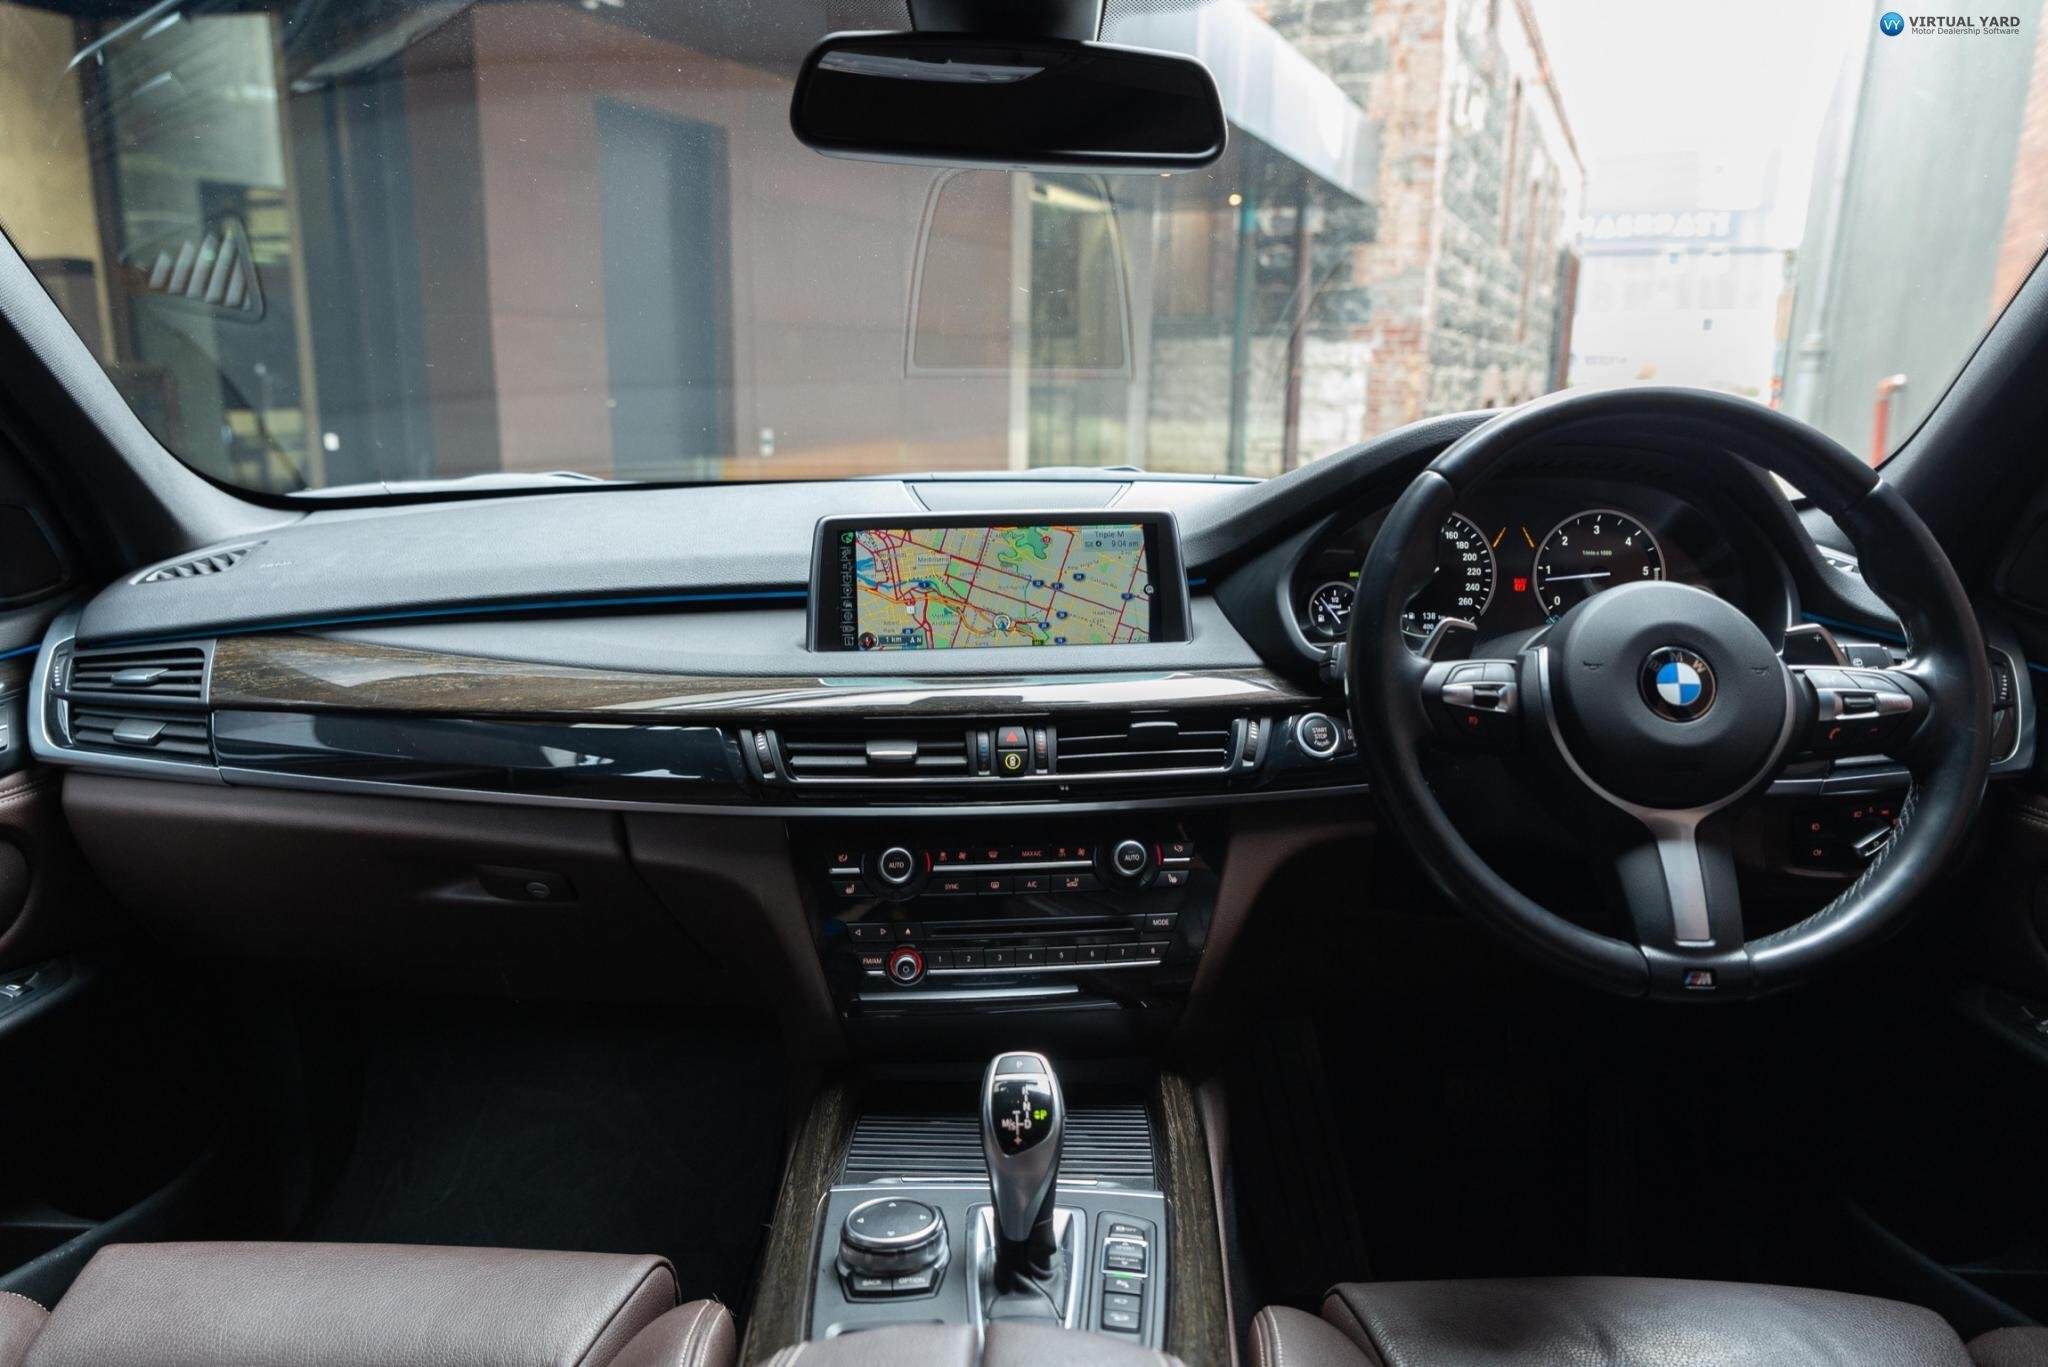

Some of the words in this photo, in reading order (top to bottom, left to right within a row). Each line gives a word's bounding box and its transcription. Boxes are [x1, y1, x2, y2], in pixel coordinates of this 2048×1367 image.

[1593, 525, 1600, 535] 3
[1095, 531, 1115, 539] Triple
[1445, 531, 1459, 540] 160
[1456, 541, 1470, 550] 180
[1562, 536, 1569, 546] 2
[1625, 537, 1632, 547] 4
[1462, 553, 1478, 561] 200
[1467, 567, 1482, 576] 220
[1545, 565, 1551, 575] 1
[1642, 566, 1649, 576] 5
[1465, 583, 1480, 592] 240
[1458, 597, 1473, 606] 260
[1553, 595, 1561, 606] 0
[1422, 612, 1436, 620] 138
[891, 635, 902, 643] km
[1016, 1060, 1023, 1069] P
[1022, 1101, 1031, 1111] N
[1024, 1119, 1032, 1129] D
